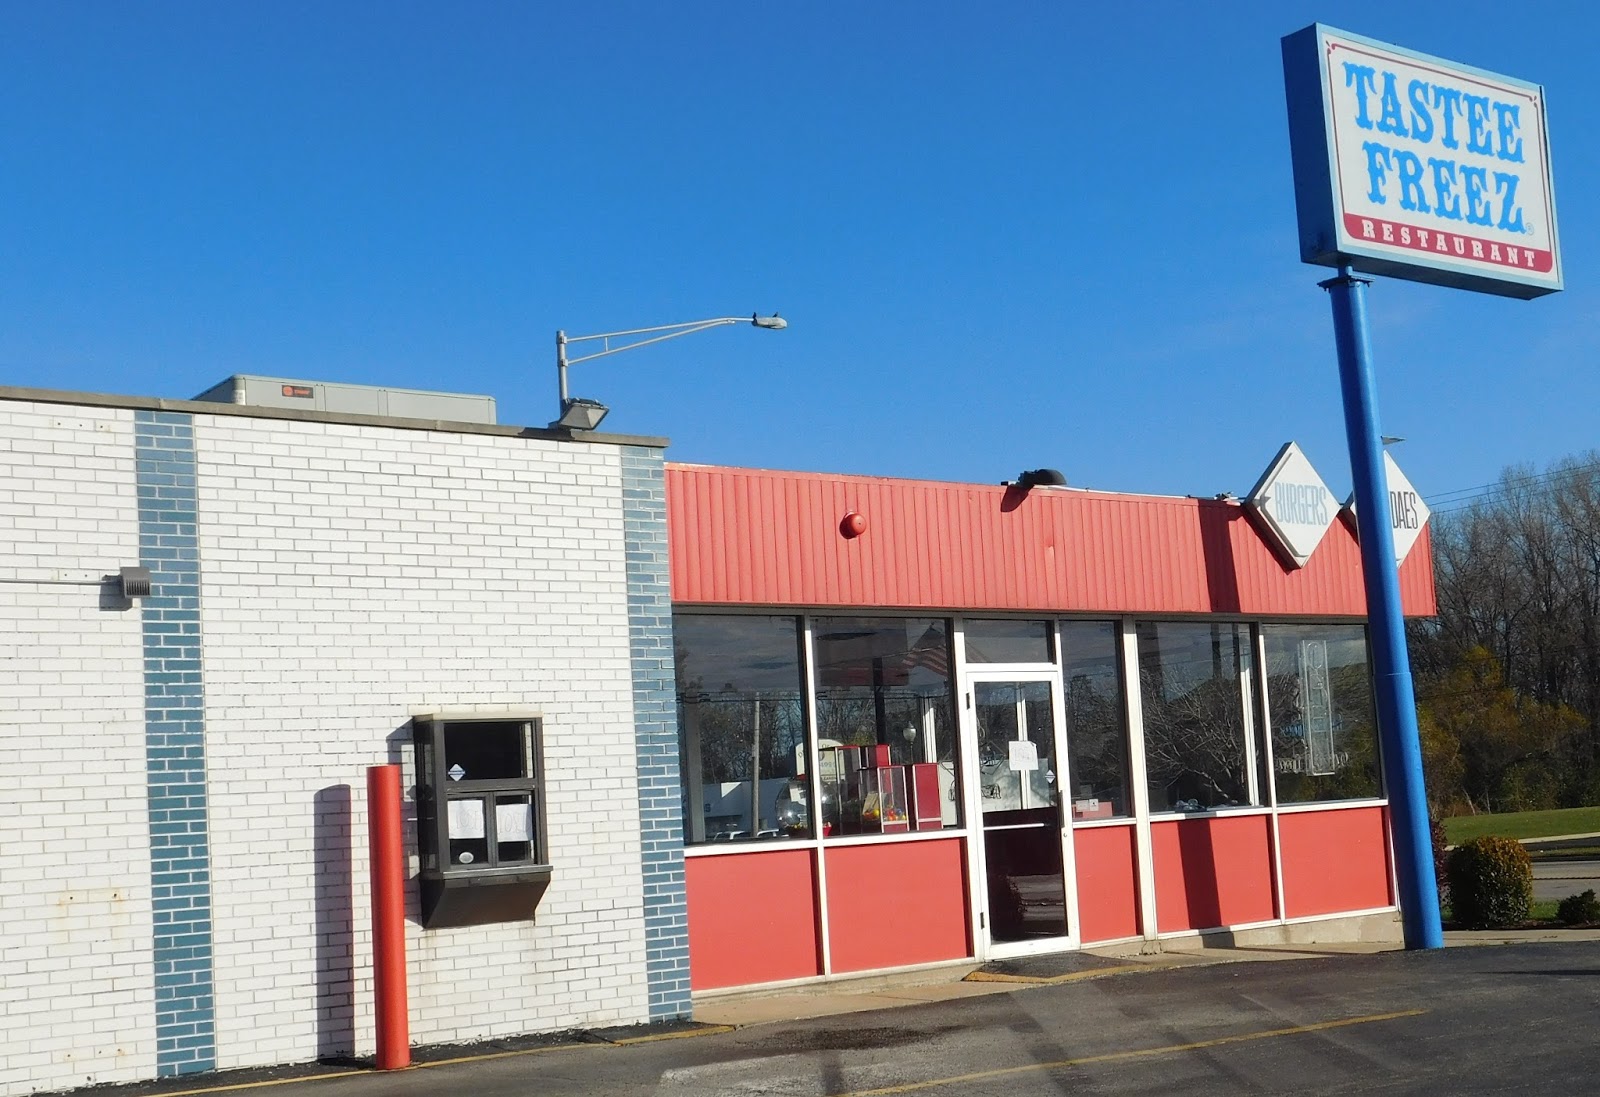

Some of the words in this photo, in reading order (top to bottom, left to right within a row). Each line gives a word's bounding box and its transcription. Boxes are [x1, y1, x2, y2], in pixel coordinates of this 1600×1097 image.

[1342, 61, 1525, 163] TASTEE
[1362, 140, 1526, 233] FREEZ
[1361, 218, 1536, 267] RESTAURANT
[1274, 481, 1328, 526] BURGERS
[1389, 490, 1419, 530] DAES
